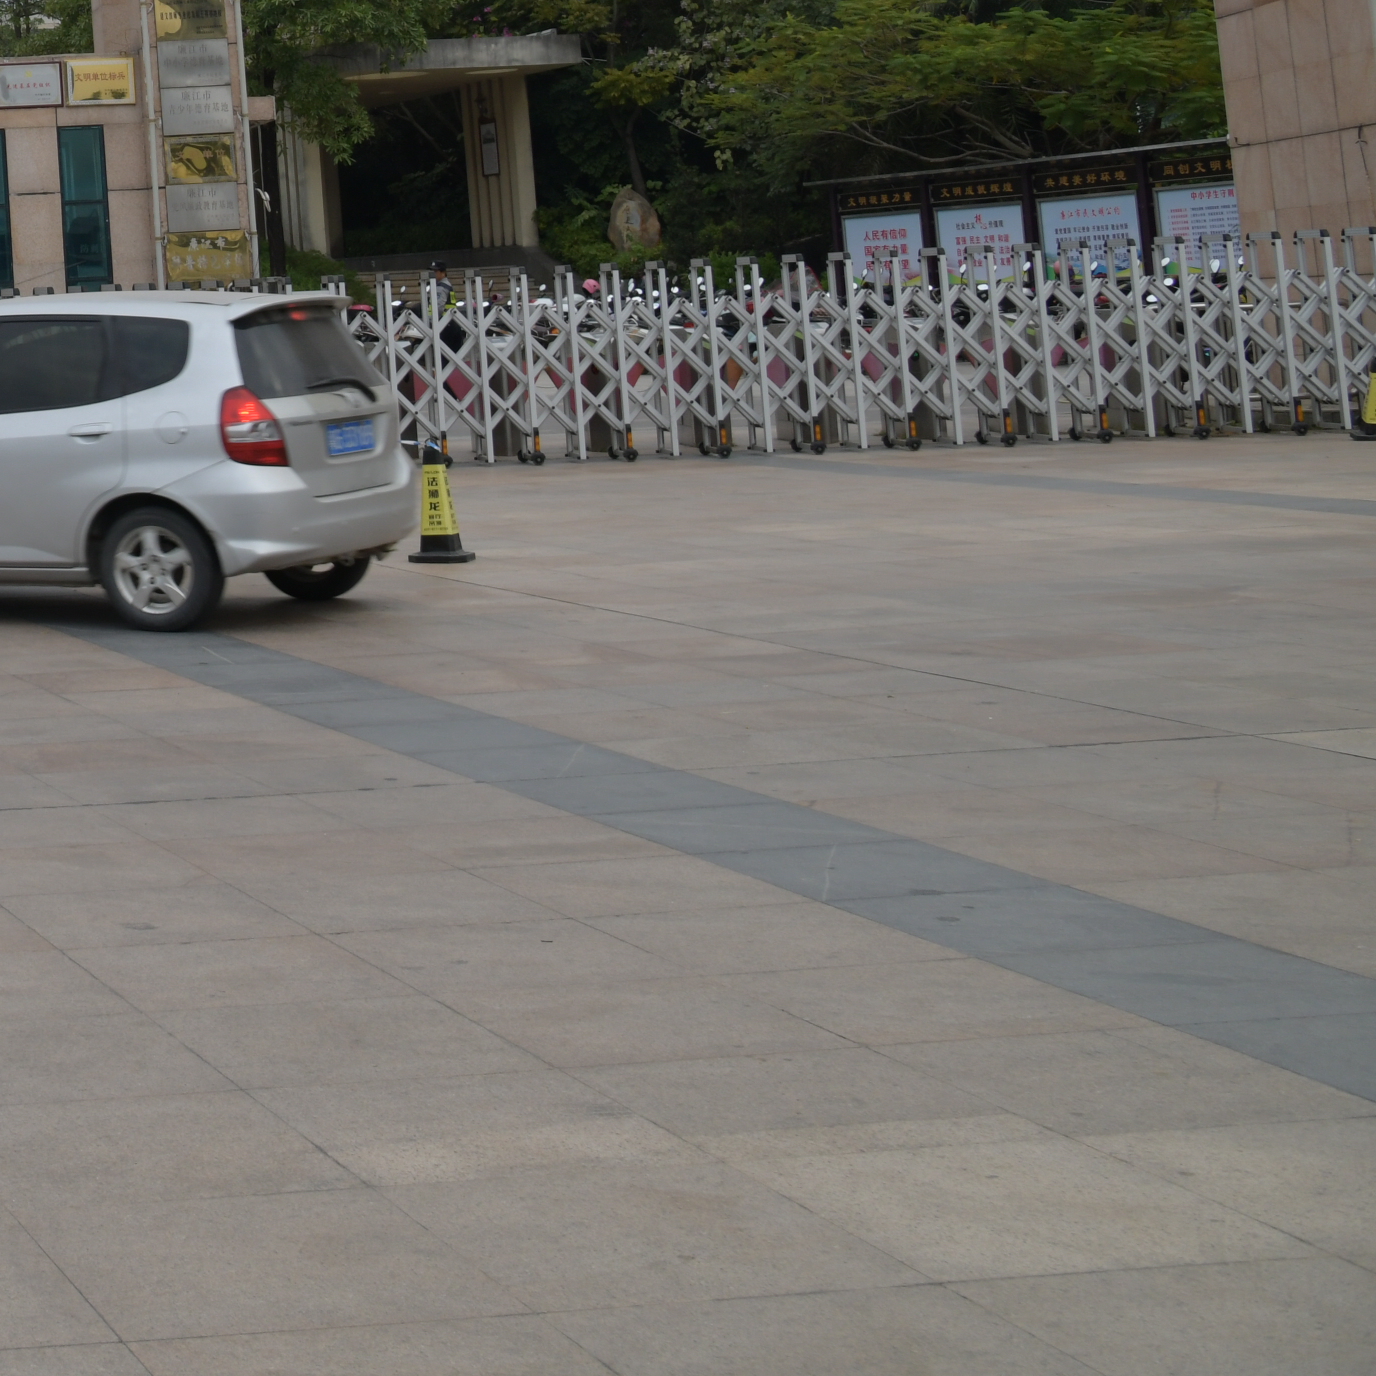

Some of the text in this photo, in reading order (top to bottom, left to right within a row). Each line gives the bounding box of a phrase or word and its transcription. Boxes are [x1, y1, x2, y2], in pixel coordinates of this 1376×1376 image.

[74, 71, 127, 83] 文明单位标兵
[1044, 170, 1127, 188] 共建美好环境
[863, 228, 908, 241] 人民有信仰
